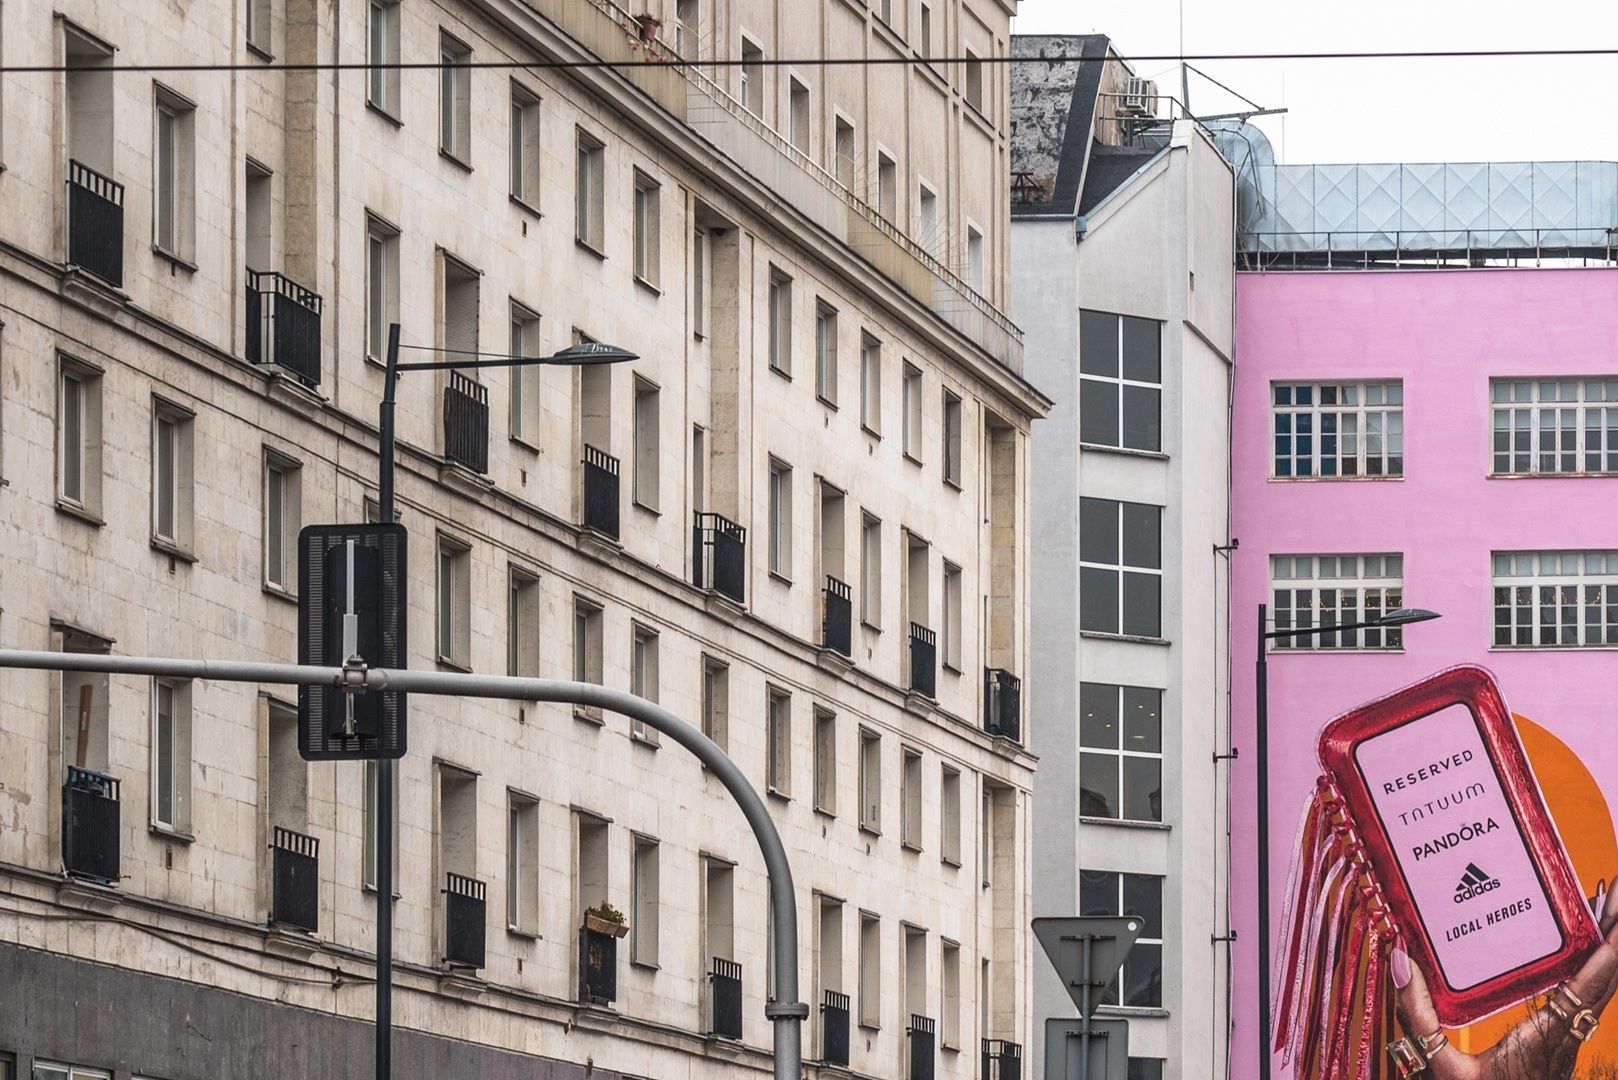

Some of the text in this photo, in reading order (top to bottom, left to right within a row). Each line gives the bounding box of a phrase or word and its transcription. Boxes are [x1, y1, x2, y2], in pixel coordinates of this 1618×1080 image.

[1383, 749, 1474, 795] RESERVED
[1397, 782, 1485, 826] TATUUM
[1411, 817, 1500, 861] PANDORA
[1453, 876, 1501, 904] adidas
[1446, 898, 1533, 942] LOCAL HEROES
